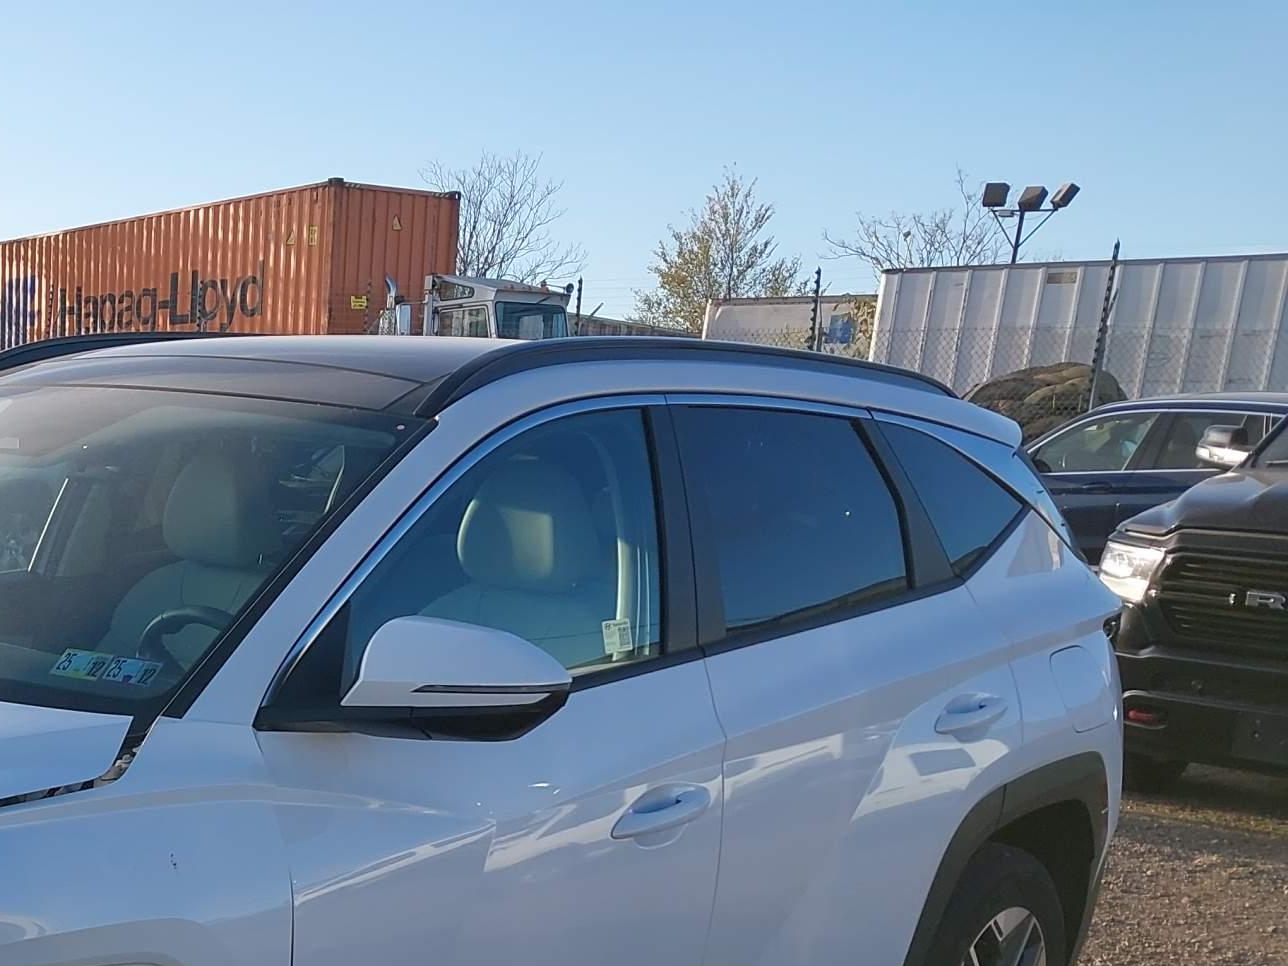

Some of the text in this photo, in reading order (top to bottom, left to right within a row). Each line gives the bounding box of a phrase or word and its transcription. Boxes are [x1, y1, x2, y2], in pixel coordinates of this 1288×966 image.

[58, 260, 264, 336] Hapag-Lloyd
[56, 652, 106, 677] 25 12
[106, 659, 156, 685] 25 12
